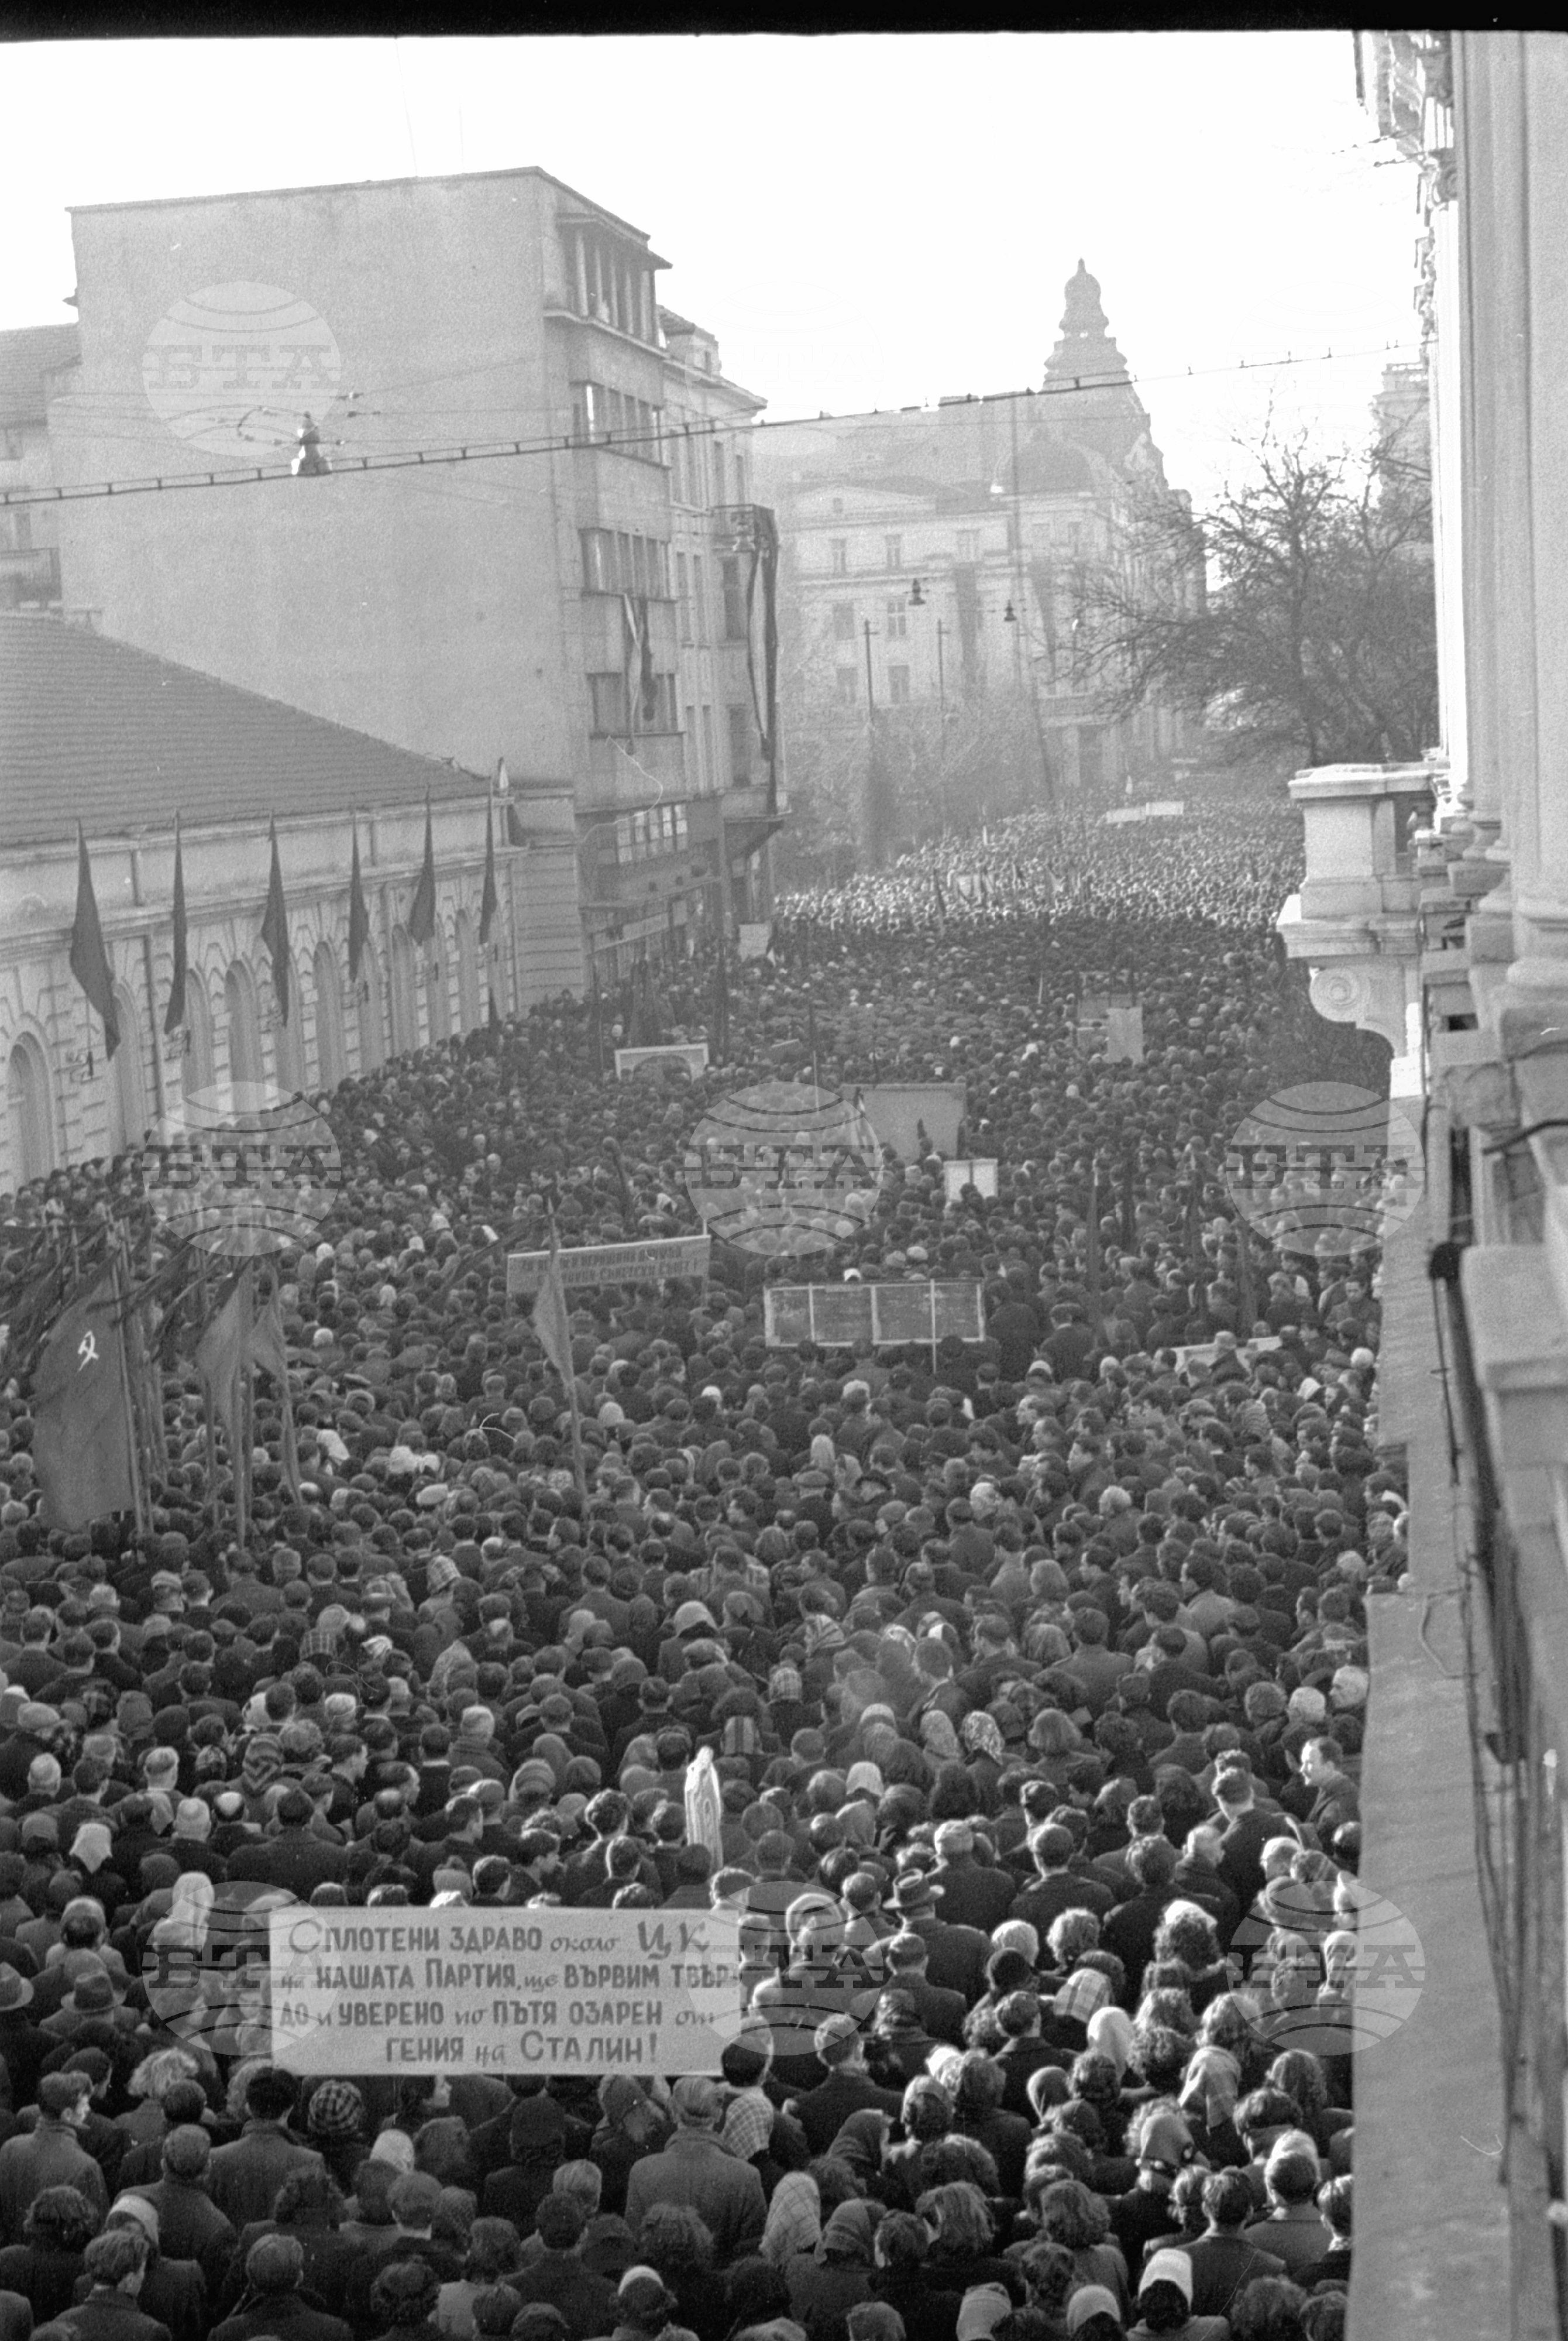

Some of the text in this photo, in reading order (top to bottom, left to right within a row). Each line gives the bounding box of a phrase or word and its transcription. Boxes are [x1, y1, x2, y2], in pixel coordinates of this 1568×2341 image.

[450, 1927, 542, 1954] ЗДРАВО
[550, 1936, 620, 1952] около
[317, 1964, 414, 1990] НАШАТА
[524, 1972, 558, 1992] ще
[564, 1964, 659, 1989] ВЪРВИМ
[279, 2000, 309, 2027] ДО
[338, 2001, 444, 2027] УВЕРЕНО
[493, 2000, 557, 2026] ПЪТЯ
[569, 2000, 662, 2026] ОЗАРЕН
[386, 2037, 464, 2063] ГЕНИЯ
[475, 2044, 505, 2068] на
